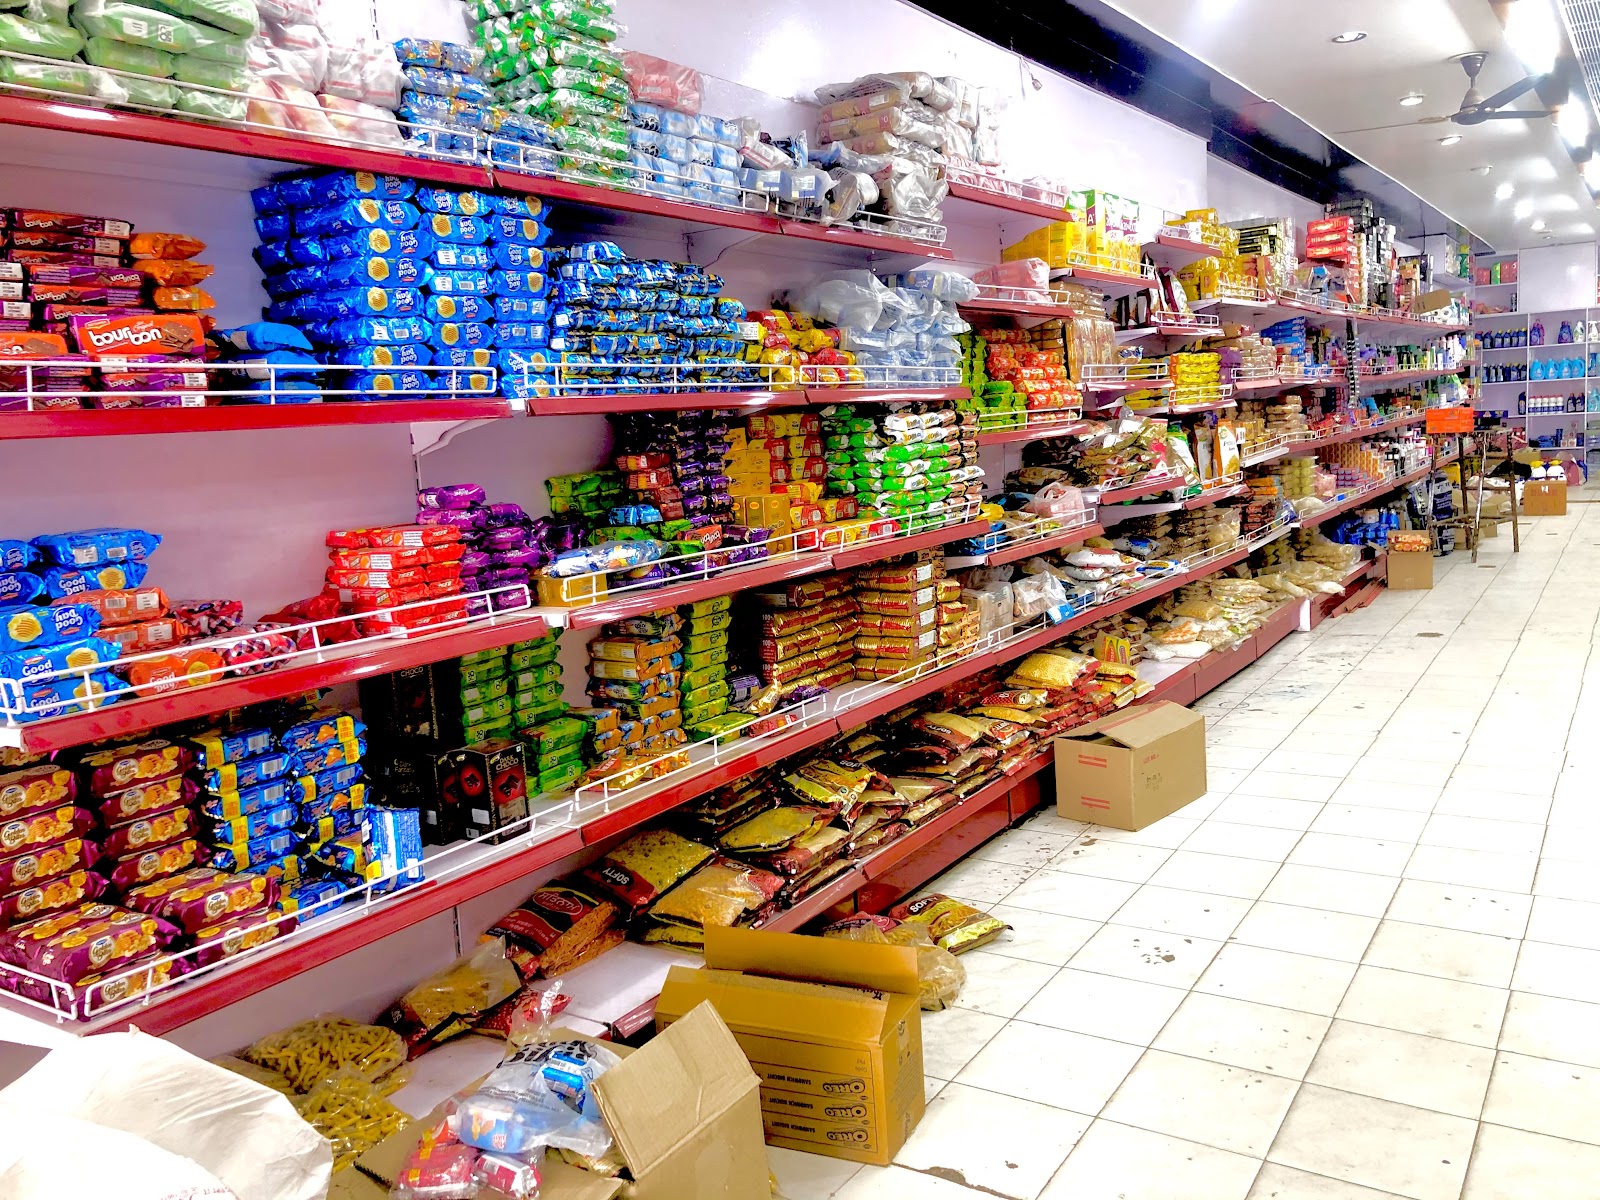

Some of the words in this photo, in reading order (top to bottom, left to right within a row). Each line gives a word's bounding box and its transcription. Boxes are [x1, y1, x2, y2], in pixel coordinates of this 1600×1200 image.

[88, 326, 162, 347] bourbon
[0, 582, 21, 595] Goo
[59, 575, 86, 588] Good
[64, 584, 87, 596] Day
[55, 608, 79, 622] Day
[55, 616, 83, 631] Good
[22, 661, 53, 676] Good
[400, 667, 424, 677] CHOCO
[496, 758, 519, 770] CHOCO
[602, 867, 630, 885] SOFTY
[910, 896, 938, 913] SOFTY
[823, 1079, 866, 1093] OREO
[825, 1104, 867, 1118] OREO
[827, 1128, 868, 1142] OREO
